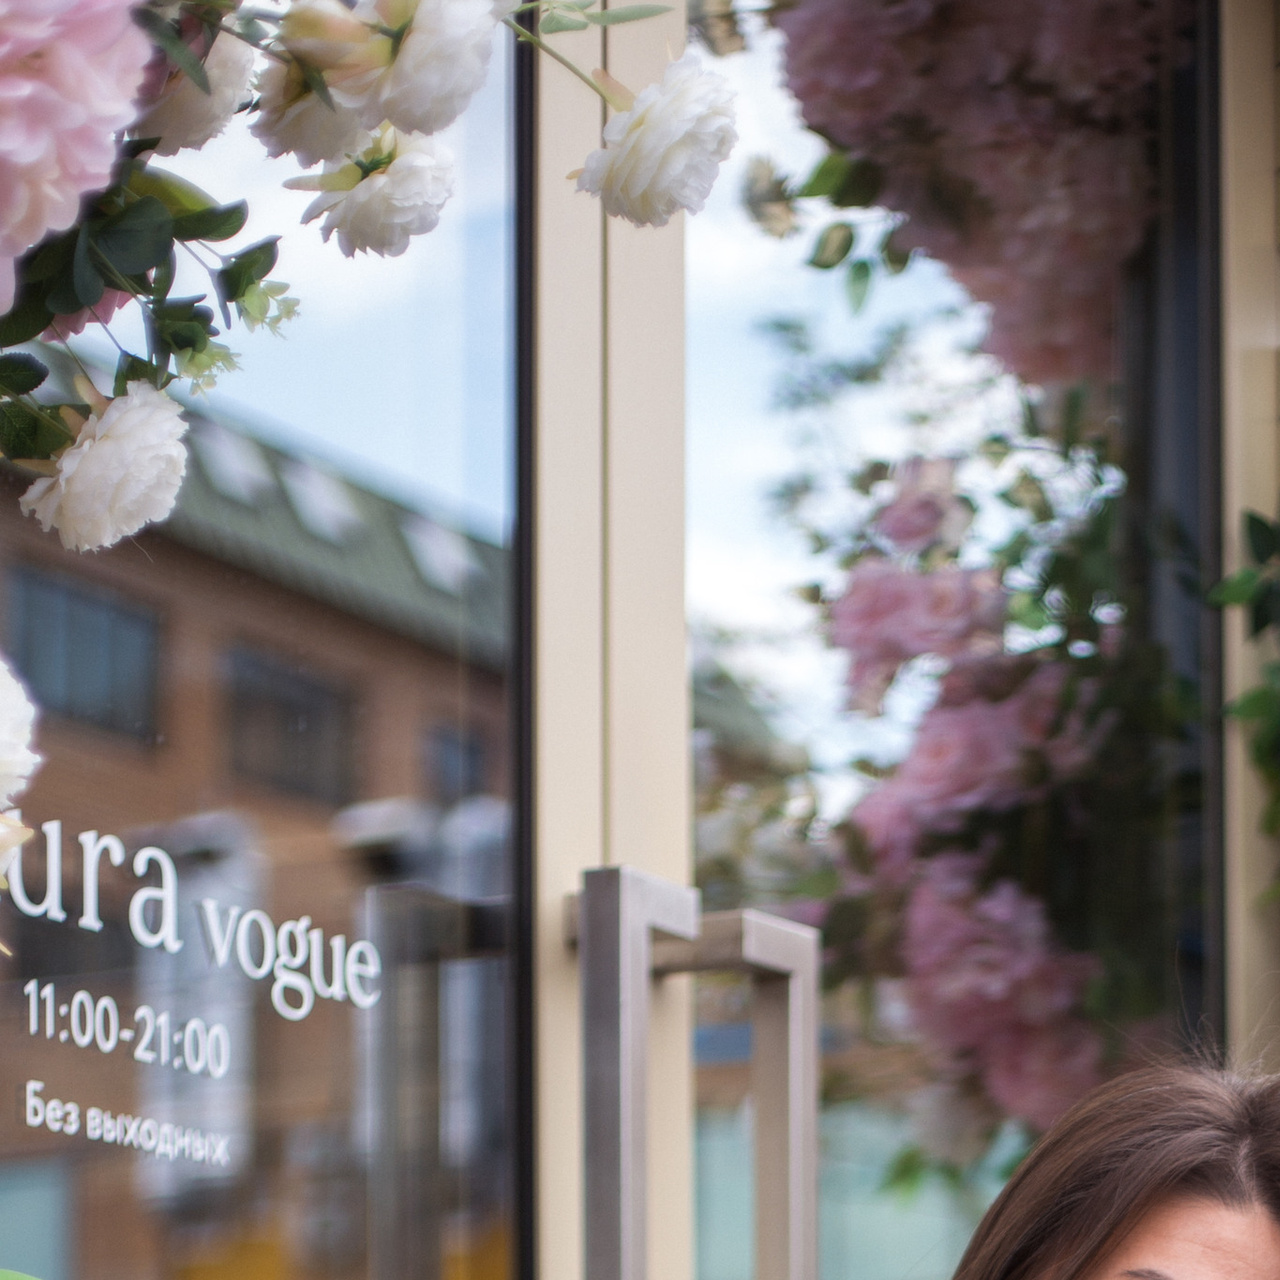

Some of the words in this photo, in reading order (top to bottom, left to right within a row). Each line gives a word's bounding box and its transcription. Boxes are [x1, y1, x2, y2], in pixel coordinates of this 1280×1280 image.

[203, 898, 382, 1021] vogue
[24, 979, 231, 1079] 11:00-21:00
[26, 1079, 80, 1135] Без
[86, 1106, 231, 1168] выходных
